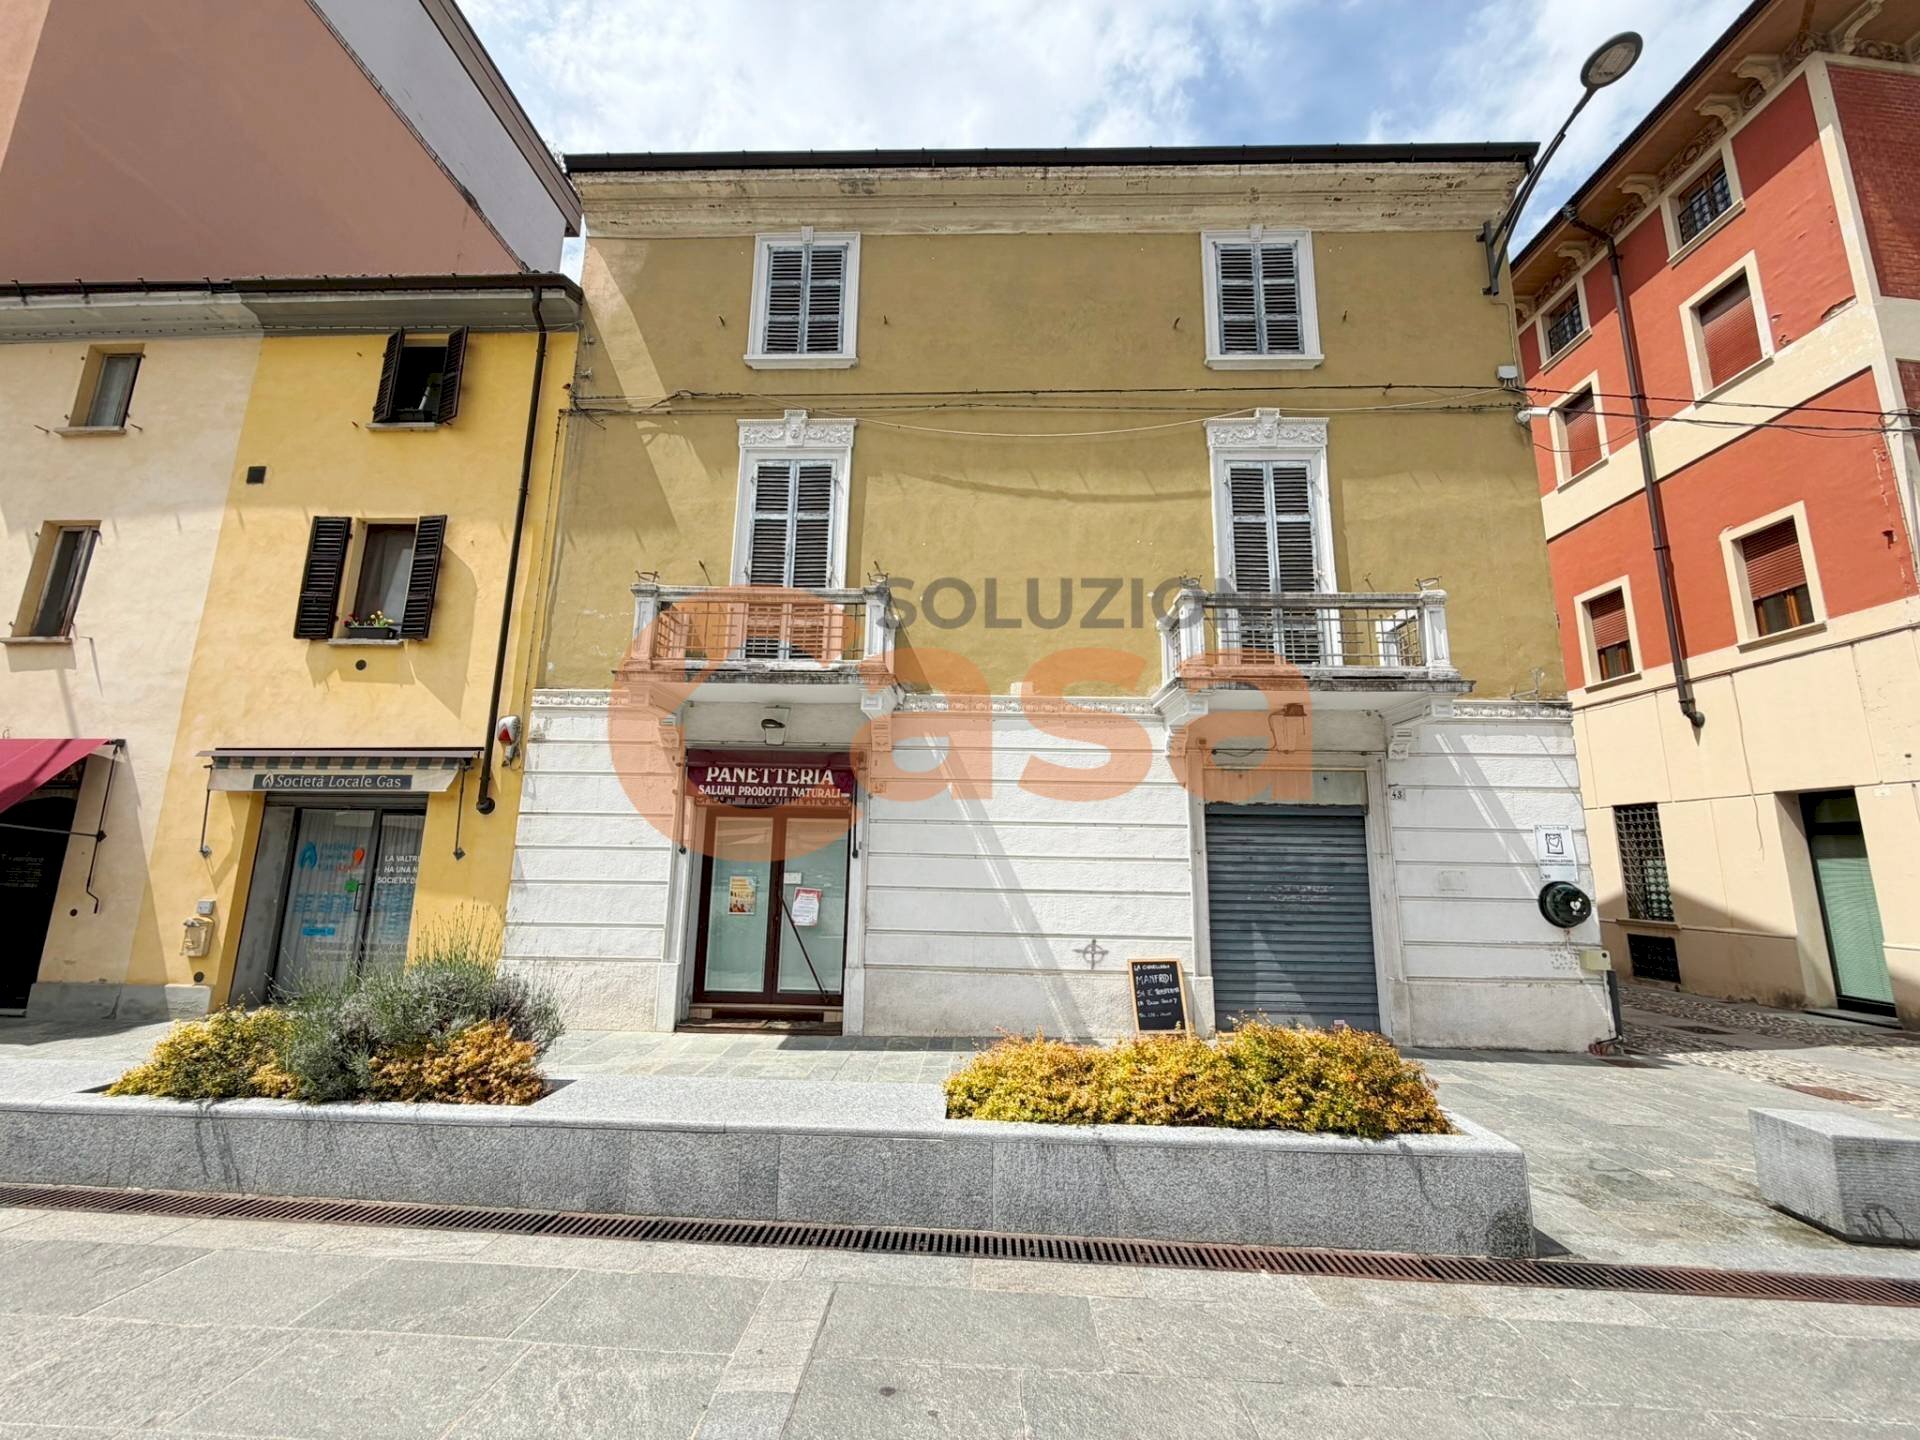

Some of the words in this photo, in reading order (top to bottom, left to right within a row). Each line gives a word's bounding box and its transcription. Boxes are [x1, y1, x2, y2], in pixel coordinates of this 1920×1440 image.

[328, 775, 372, 788] Locale
[377, 775, 401, 788] Gas
[706, 766, 834, 785] PANETTERIA
[698, 784, 735, 796] SALUMI
[738, 785, 788, 797] PRODOTTI
[791, 786, 841, 798] NATURALI
[384, 865, 394, 873] HA
